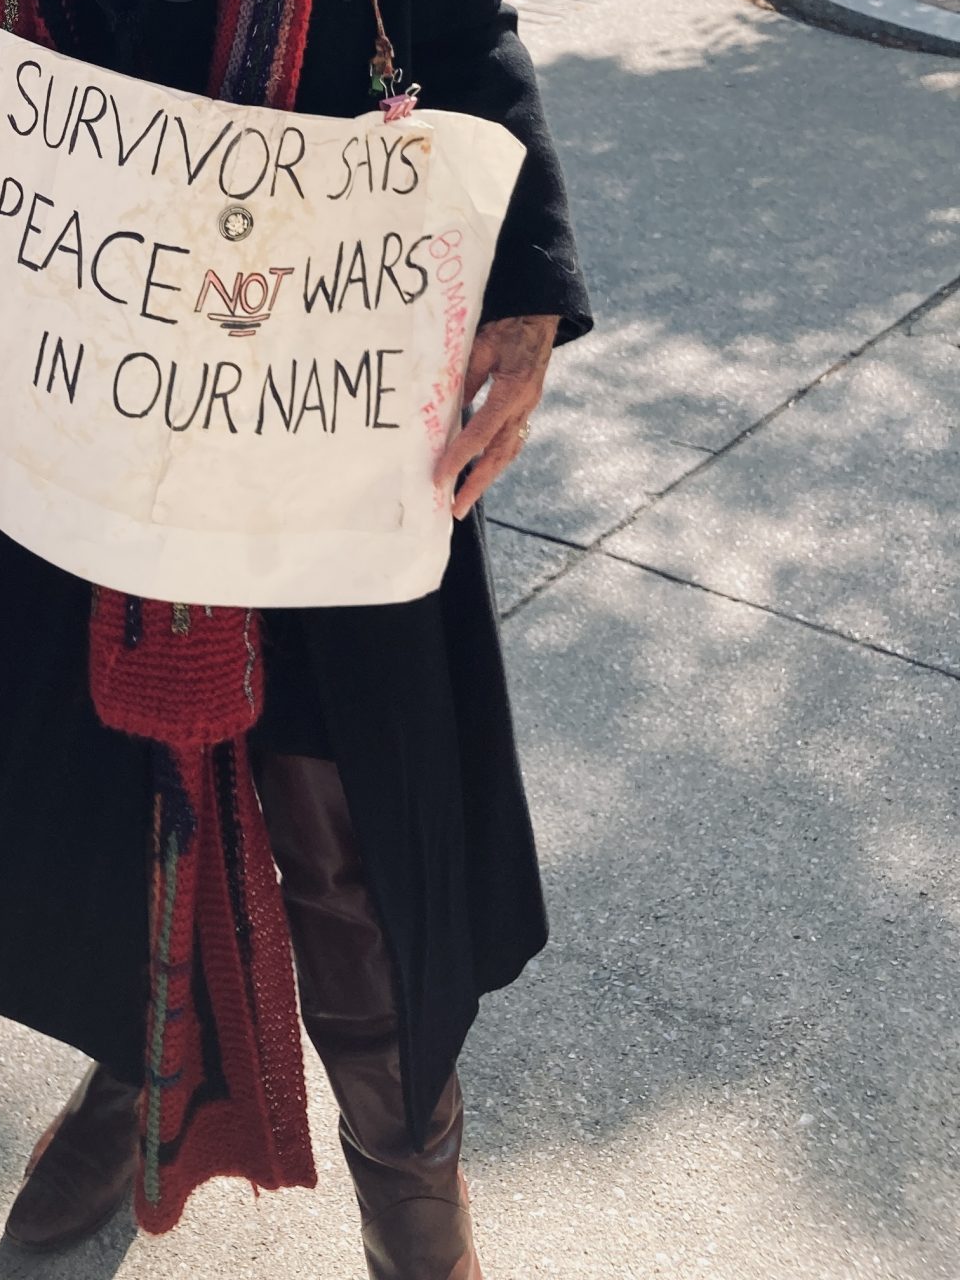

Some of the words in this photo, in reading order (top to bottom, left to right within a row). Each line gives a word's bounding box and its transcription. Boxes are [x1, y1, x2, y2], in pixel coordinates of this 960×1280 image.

[7, 60, 305, 200] SURVIVOR
[326, 135, 425, 200] SAYS
[194, 267, 295, 317] NOT
[304, 232, 432, 314] WARS
[32, 331, 85, 404] IN
[113, 352, 240, 435] OUR
[254, 349, 404, 436] NAME
